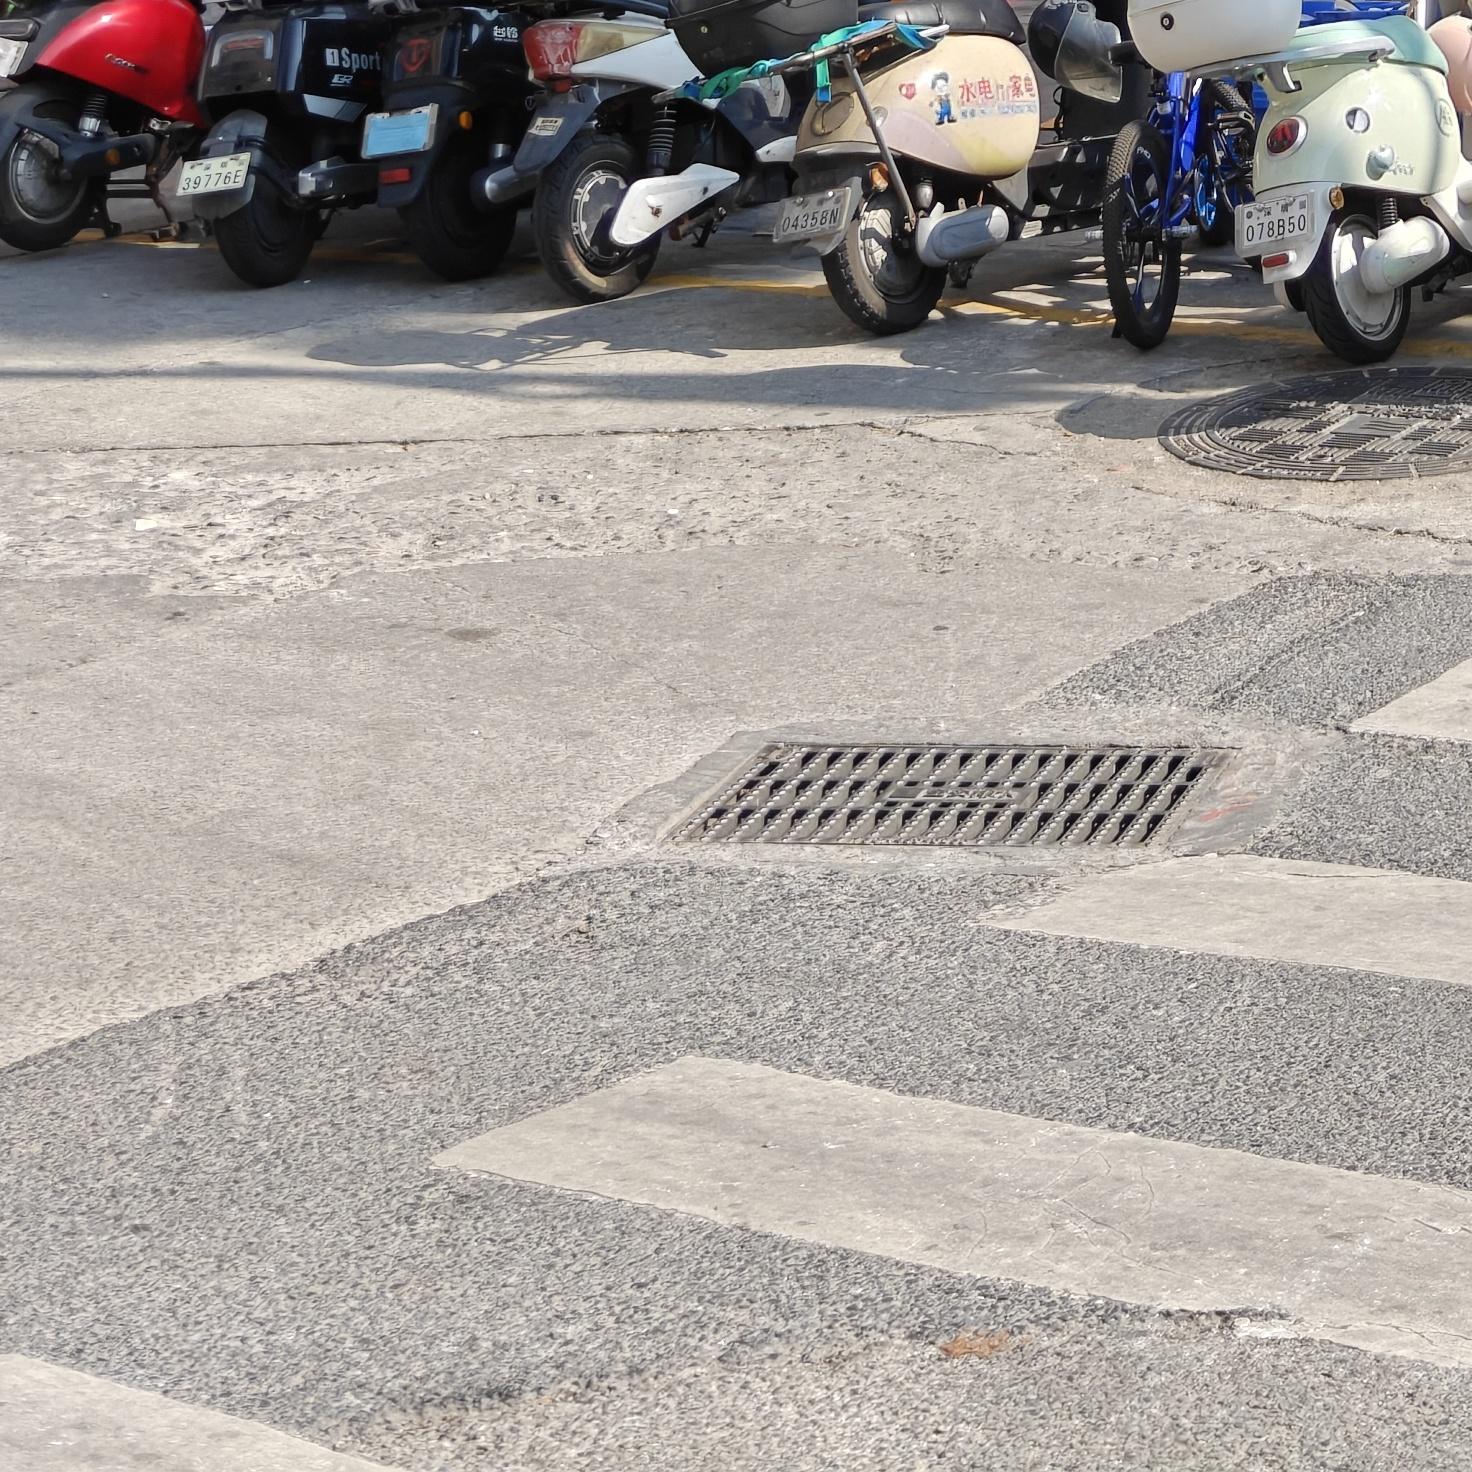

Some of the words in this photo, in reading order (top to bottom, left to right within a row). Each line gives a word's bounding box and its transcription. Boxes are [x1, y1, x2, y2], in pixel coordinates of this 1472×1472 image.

[958, 77, 994, 101] 水电
[182, 168, 243, 192] 39776E
[781, 206, 841, 232] 04358N
